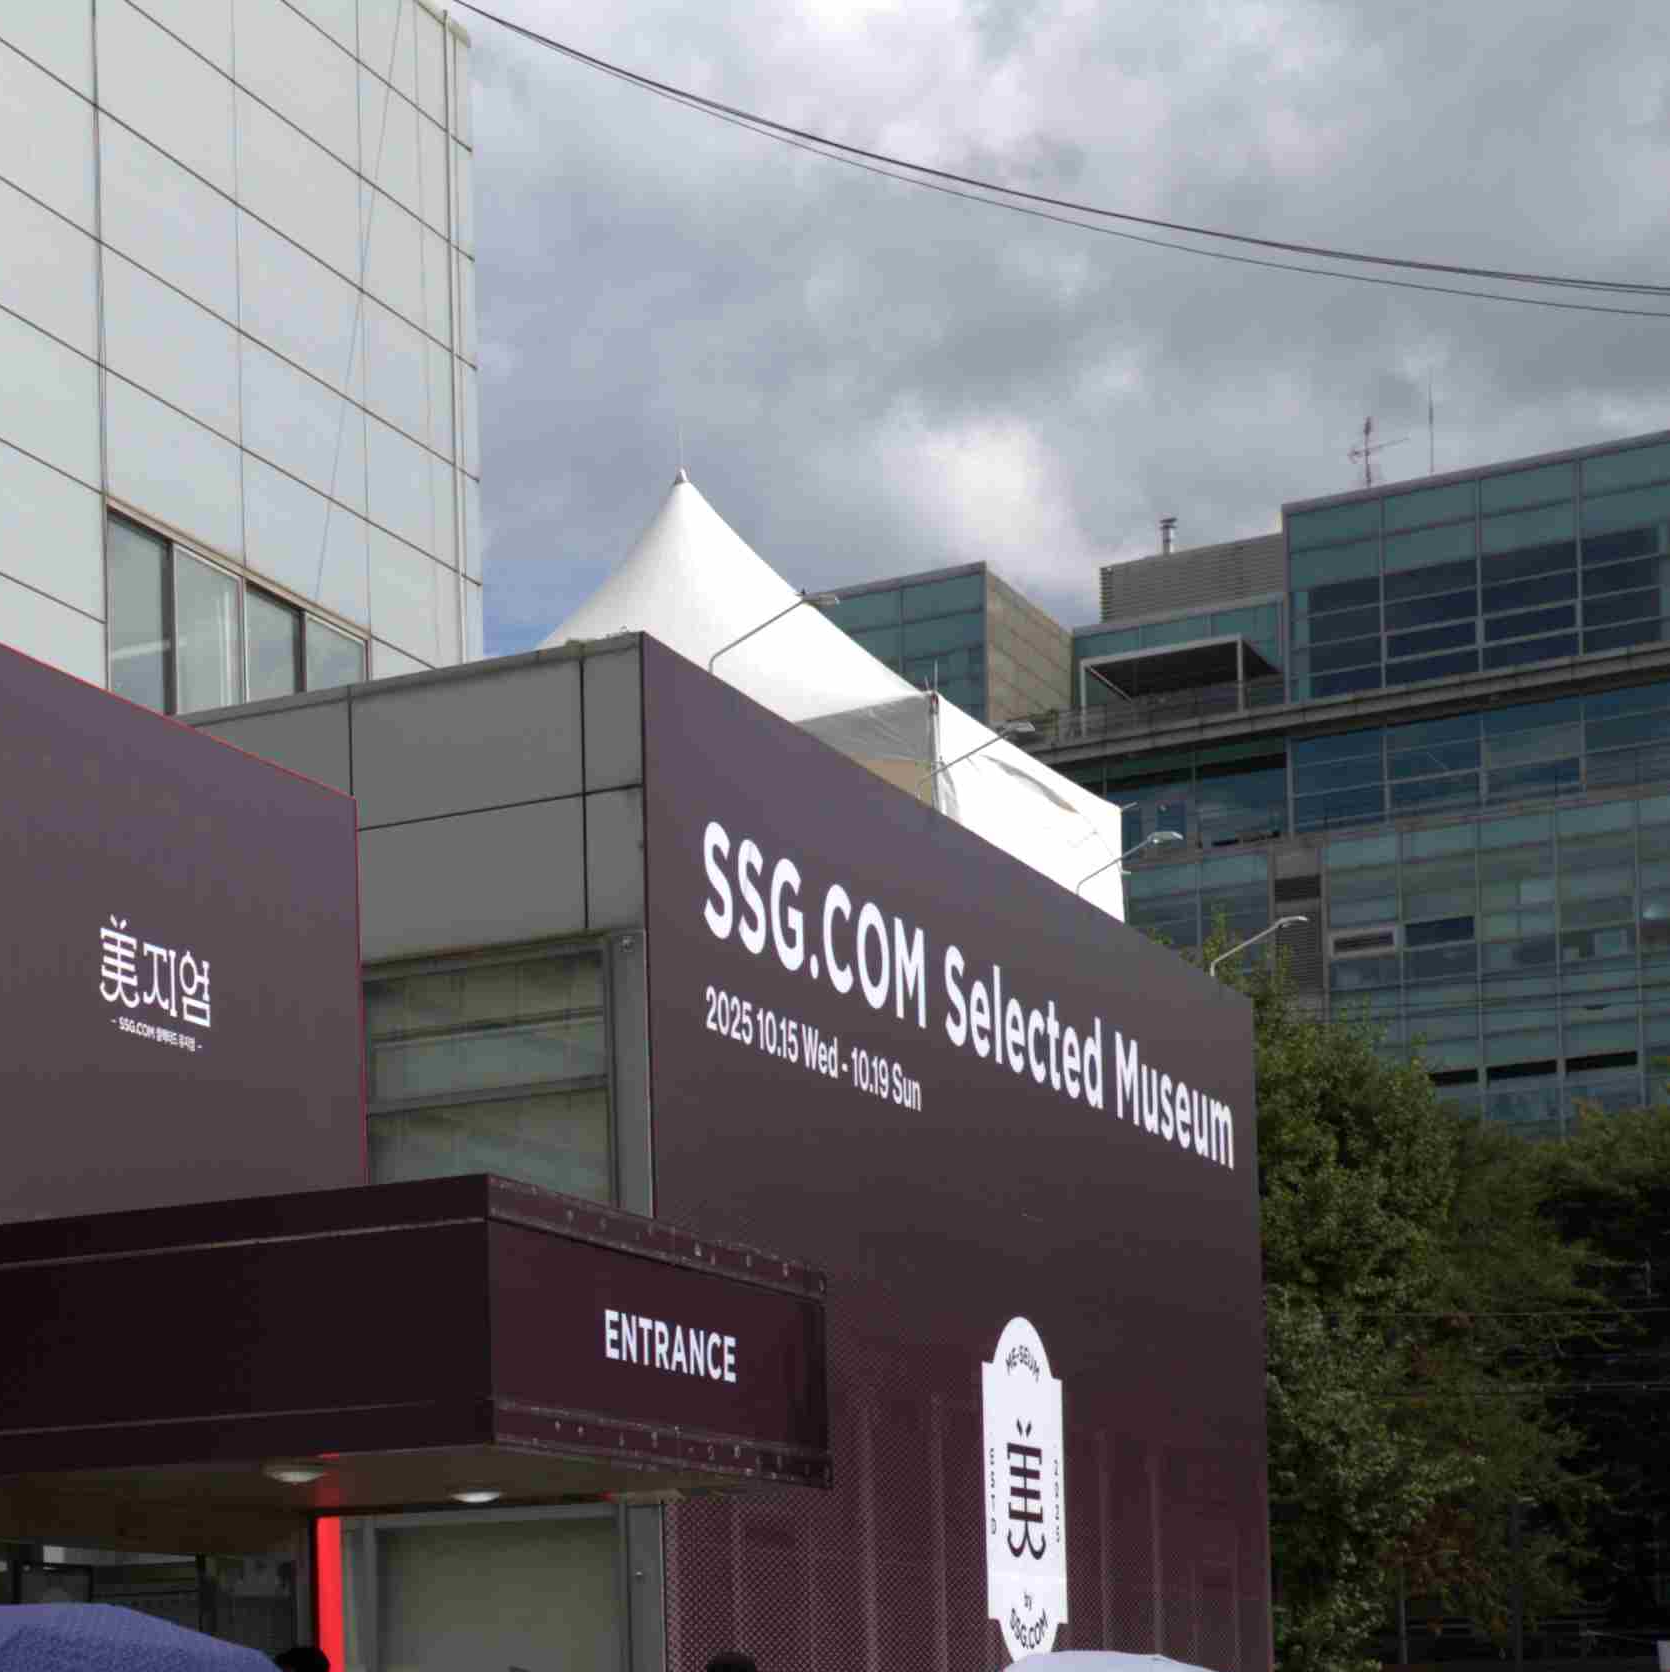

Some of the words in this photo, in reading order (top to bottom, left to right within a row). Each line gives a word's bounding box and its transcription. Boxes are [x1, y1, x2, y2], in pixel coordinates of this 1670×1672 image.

[703, 821, 927, 1028] SSG.COM
[944, 945, 1104, 1111] Selected
[1115, 1030, 1234, 1170] Museum
[705, 985, 753, 1045] 2025
[756, 1010, 799, 1064] 10.15
[801, 1022, 839, 1079] Wed
[851, 1048, 890, 1099] 10.19
[892, 1063, 922, 1112] Sun
[605, 1309, 736, 1383] ENTRANCE
[1010, 1607, 1049, 1650] SSG.COM
